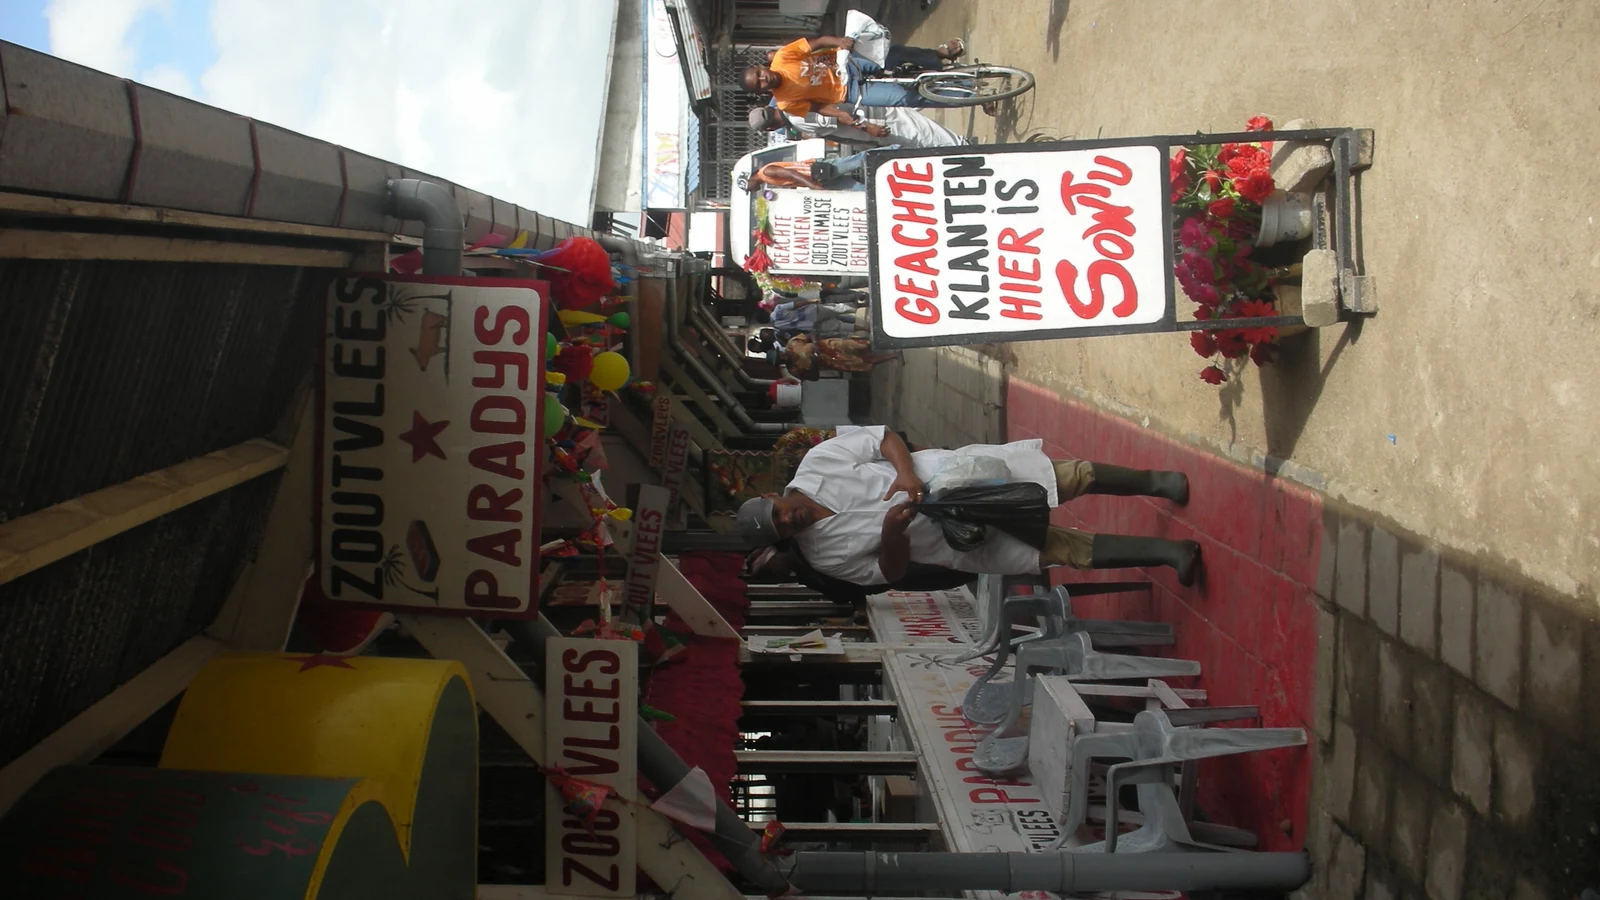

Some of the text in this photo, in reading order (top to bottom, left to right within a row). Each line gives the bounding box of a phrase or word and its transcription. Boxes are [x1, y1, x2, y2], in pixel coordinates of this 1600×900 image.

[773, 215, 791, 264] GEACHTE
[793, 196, 812, 264] KLANTEN VOOR
[811, 198, 831, 265] GOED EN MALSE
[887, 161, 940, 325] GEACHTE
[942, 156, 994, 321] KLANTEN
[997, 227, 1044, 321] HIER
[331, 277, 386, 599] ZOUTVLEES
[464, 305, 530, 609] PARADYS
[562, 648, 620, 891] ZOUVLEES
